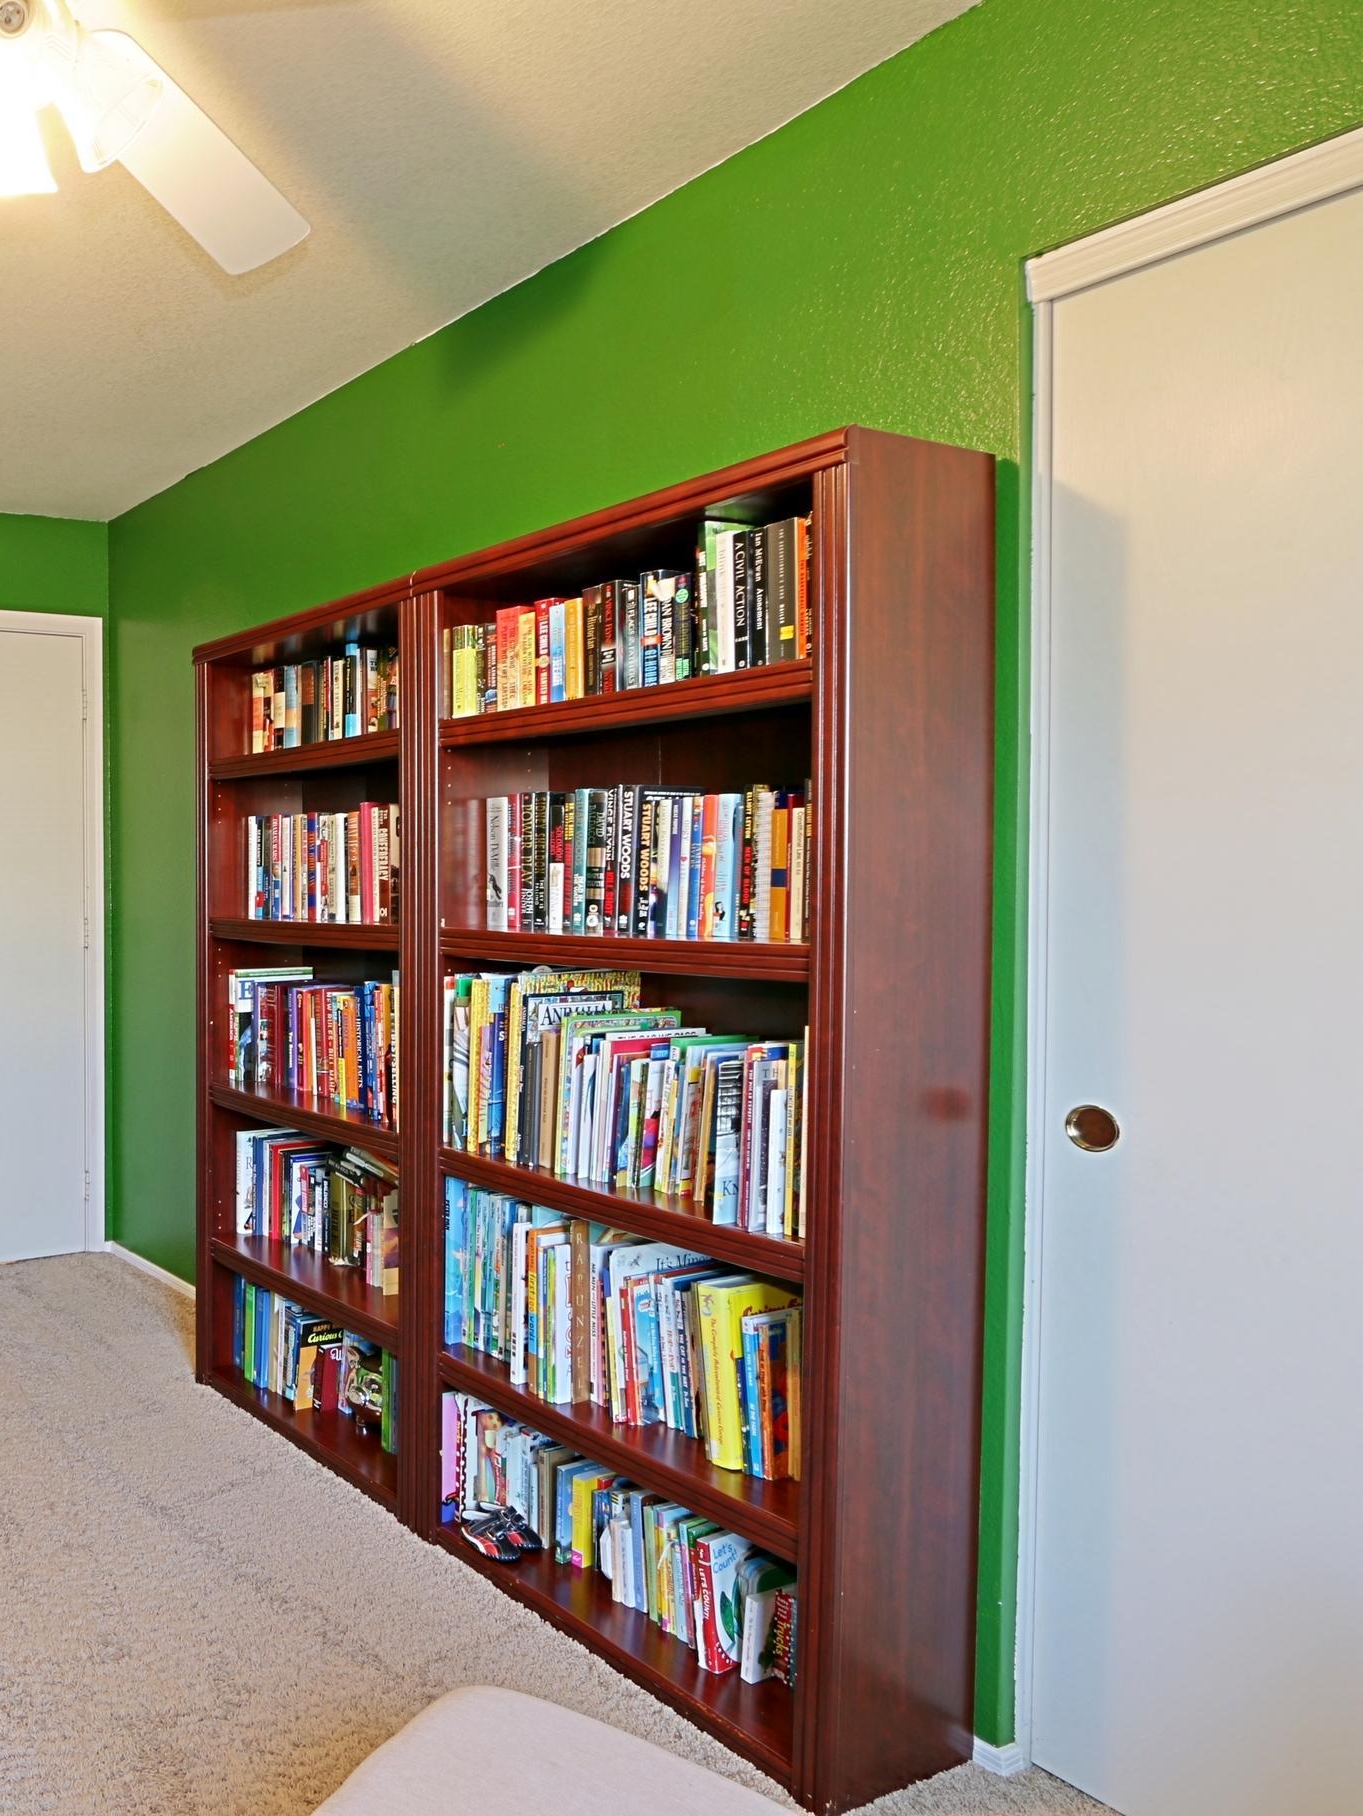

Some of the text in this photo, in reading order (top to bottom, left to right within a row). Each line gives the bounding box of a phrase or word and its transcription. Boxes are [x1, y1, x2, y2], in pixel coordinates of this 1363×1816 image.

[735, 542, 745, 628] A CIVIL ACTION
[644, 598, 657, 612] LEE
[586, 616, 597, 650] Historian
[644, 612, 657, 636] CHILD
[661, 617, 672, 650] BROWN
[540, 635, 548, 654] CHILD
[645, 650, 657, 660] 61
[490, 816, 499, 840] Nelson
[535, 796, 546, 874] SIDNEY SHELDON
[588, 804, 596, 845] BALDACCI
[596, 812, 605, 837] DAVID
[621, 791, 633, 879] STUART WOODS
[642, 804, 651, 846] STUART
[378, 828, 388, 880] CONFEDERACY
[522, 804, 532, 884] POWER PLAY
[744, 847, 752, 863] MEN
[639, 849, 649, 891] WOODS
[744, 866, 751, 875] OF
[743, 879, 751, 904] BLOOD
[575, 1232, 585, 1389] RAPUNZEL
[308, 1332, 337, 1343] Curious
[699, 1568, 707, 1588] LET'S
[776, 1621, 786, 1656] Trucks
